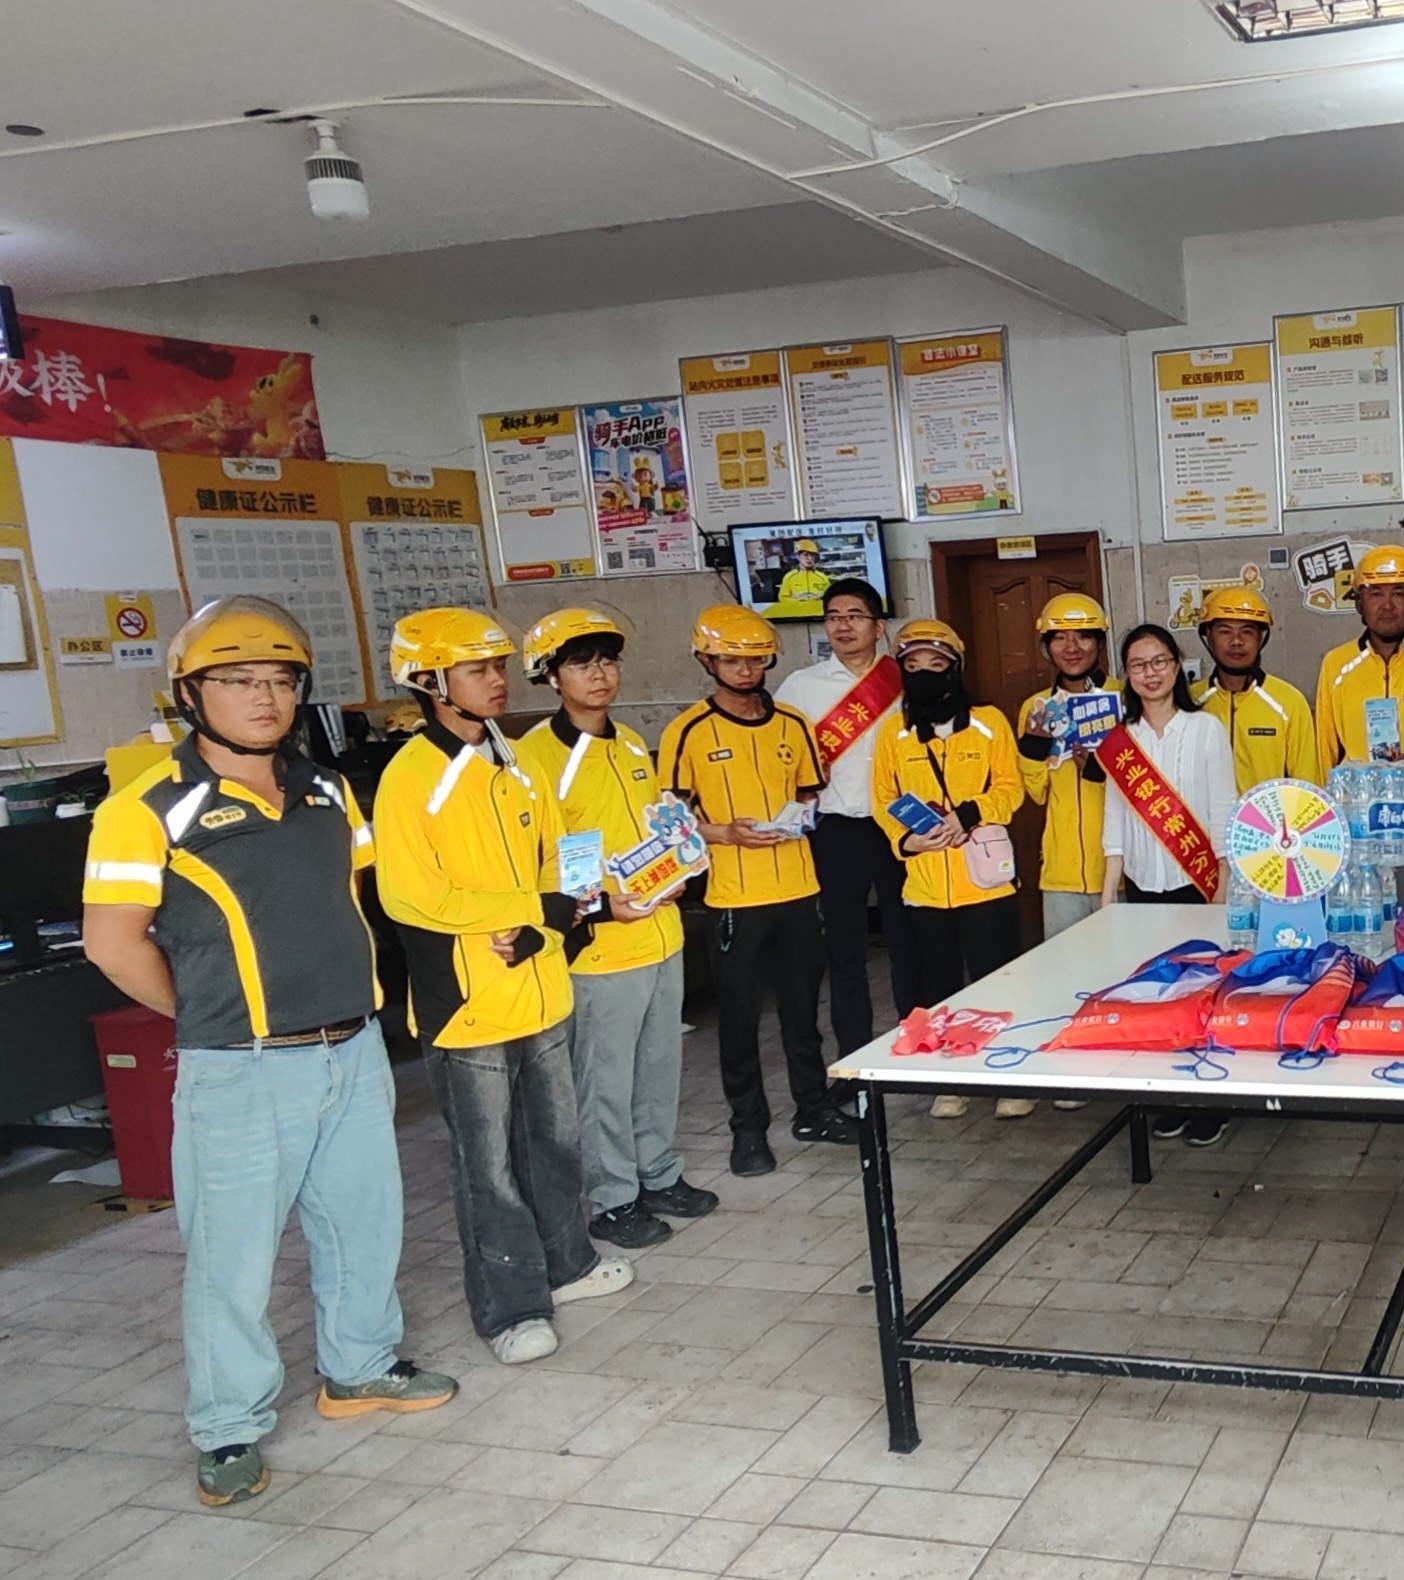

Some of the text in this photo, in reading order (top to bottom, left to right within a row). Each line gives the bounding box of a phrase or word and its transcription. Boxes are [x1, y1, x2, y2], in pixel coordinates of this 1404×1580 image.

[1181, 370, 1245, 386] 配送服务规范
[196, 489, 318, 514] 健康证公示栏
[367, 496, 463, 519] 健康证公示栏
[1302, 545, 1350, 580] 骑手
[67, 641, 104, 652] 办公区
[1211, 1015, 1233, 1025] 业银行
